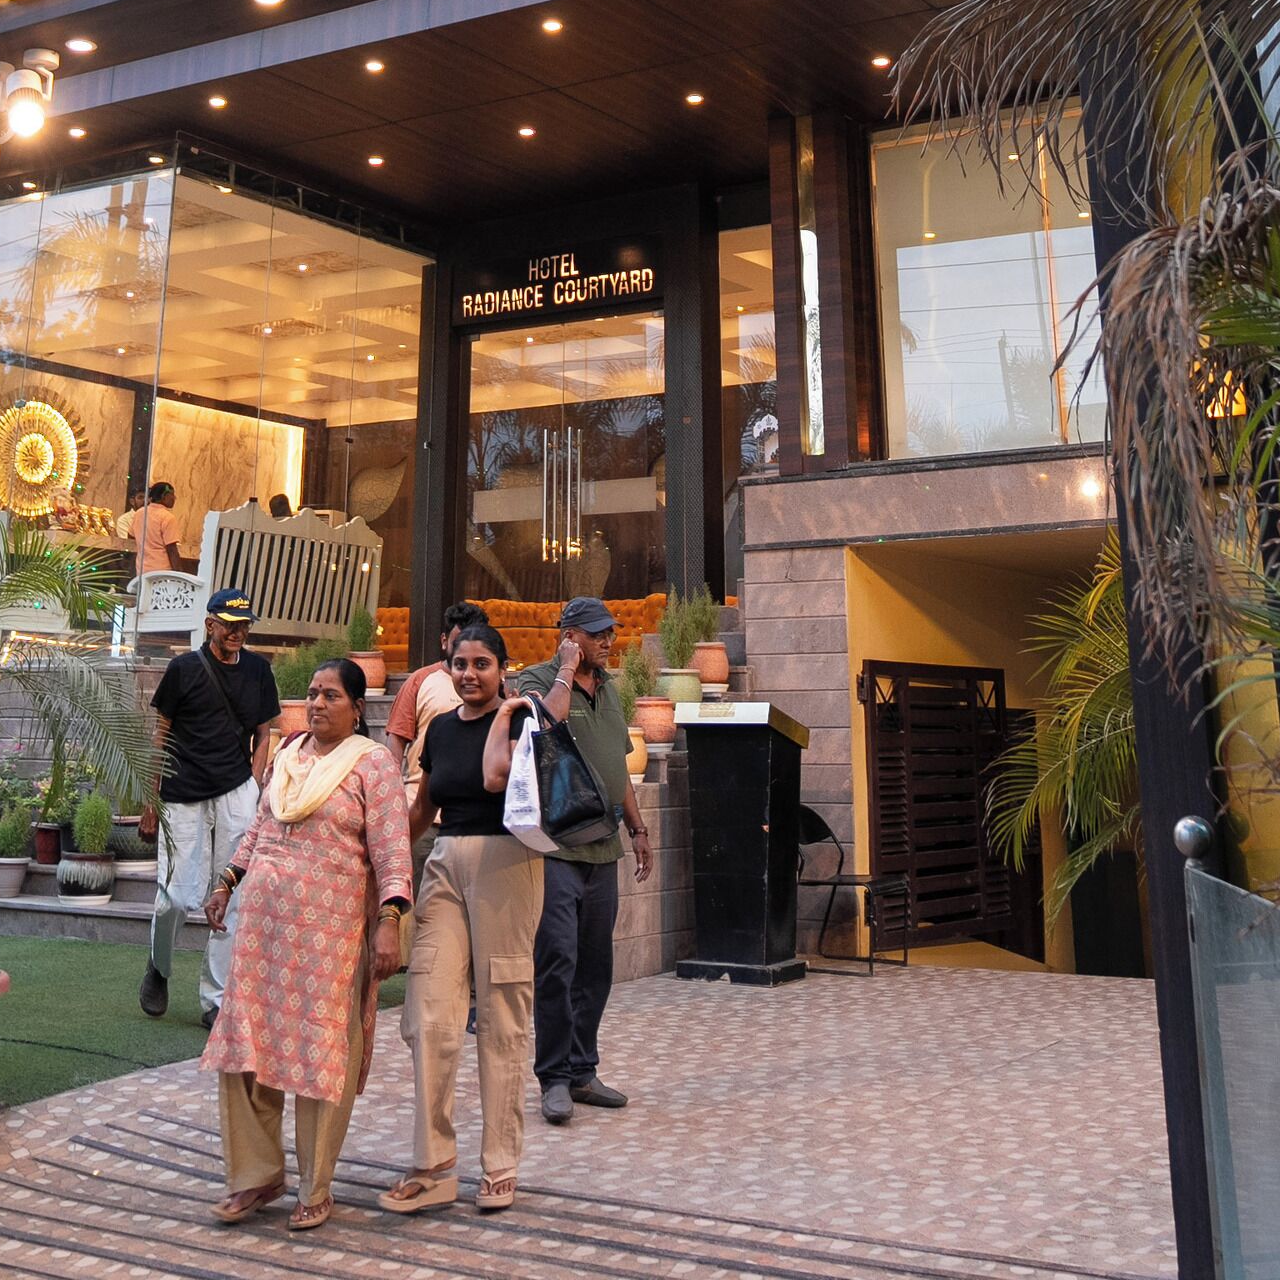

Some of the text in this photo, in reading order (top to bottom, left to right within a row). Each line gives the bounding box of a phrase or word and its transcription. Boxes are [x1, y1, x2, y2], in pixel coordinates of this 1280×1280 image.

[527, 253, 580, 282] HOTEL
[463, 285, 544, 318] RADIANCE
[554, 268, 654, 305] COURTYARD
